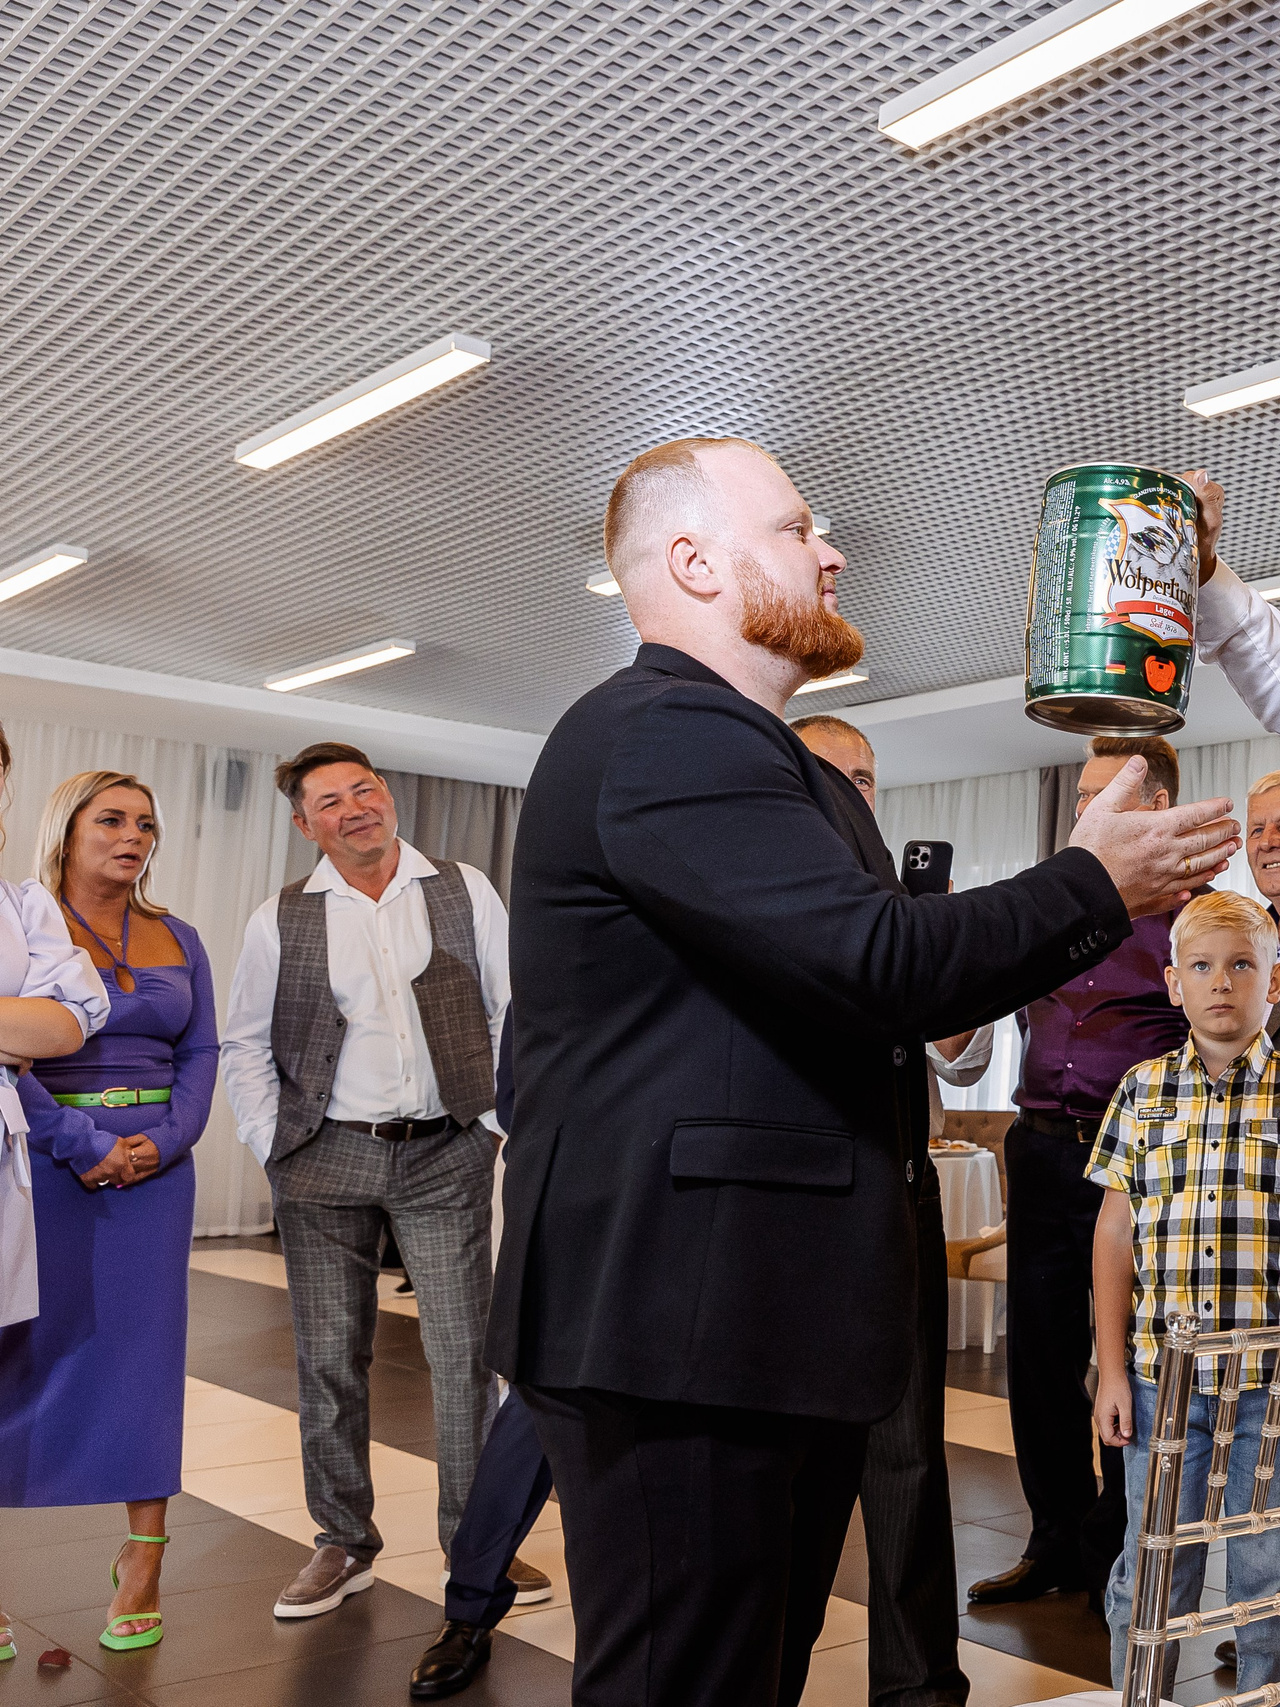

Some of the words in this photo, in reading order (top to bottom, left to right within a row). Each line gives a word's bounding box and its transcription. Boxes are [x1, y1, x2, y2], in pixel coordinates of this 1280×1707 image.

[1105, 558, 1197, 615] Wolpertinge
[1155, 604, 1175, 617] Lager
[1149, 617, 1164, 629] Seit
